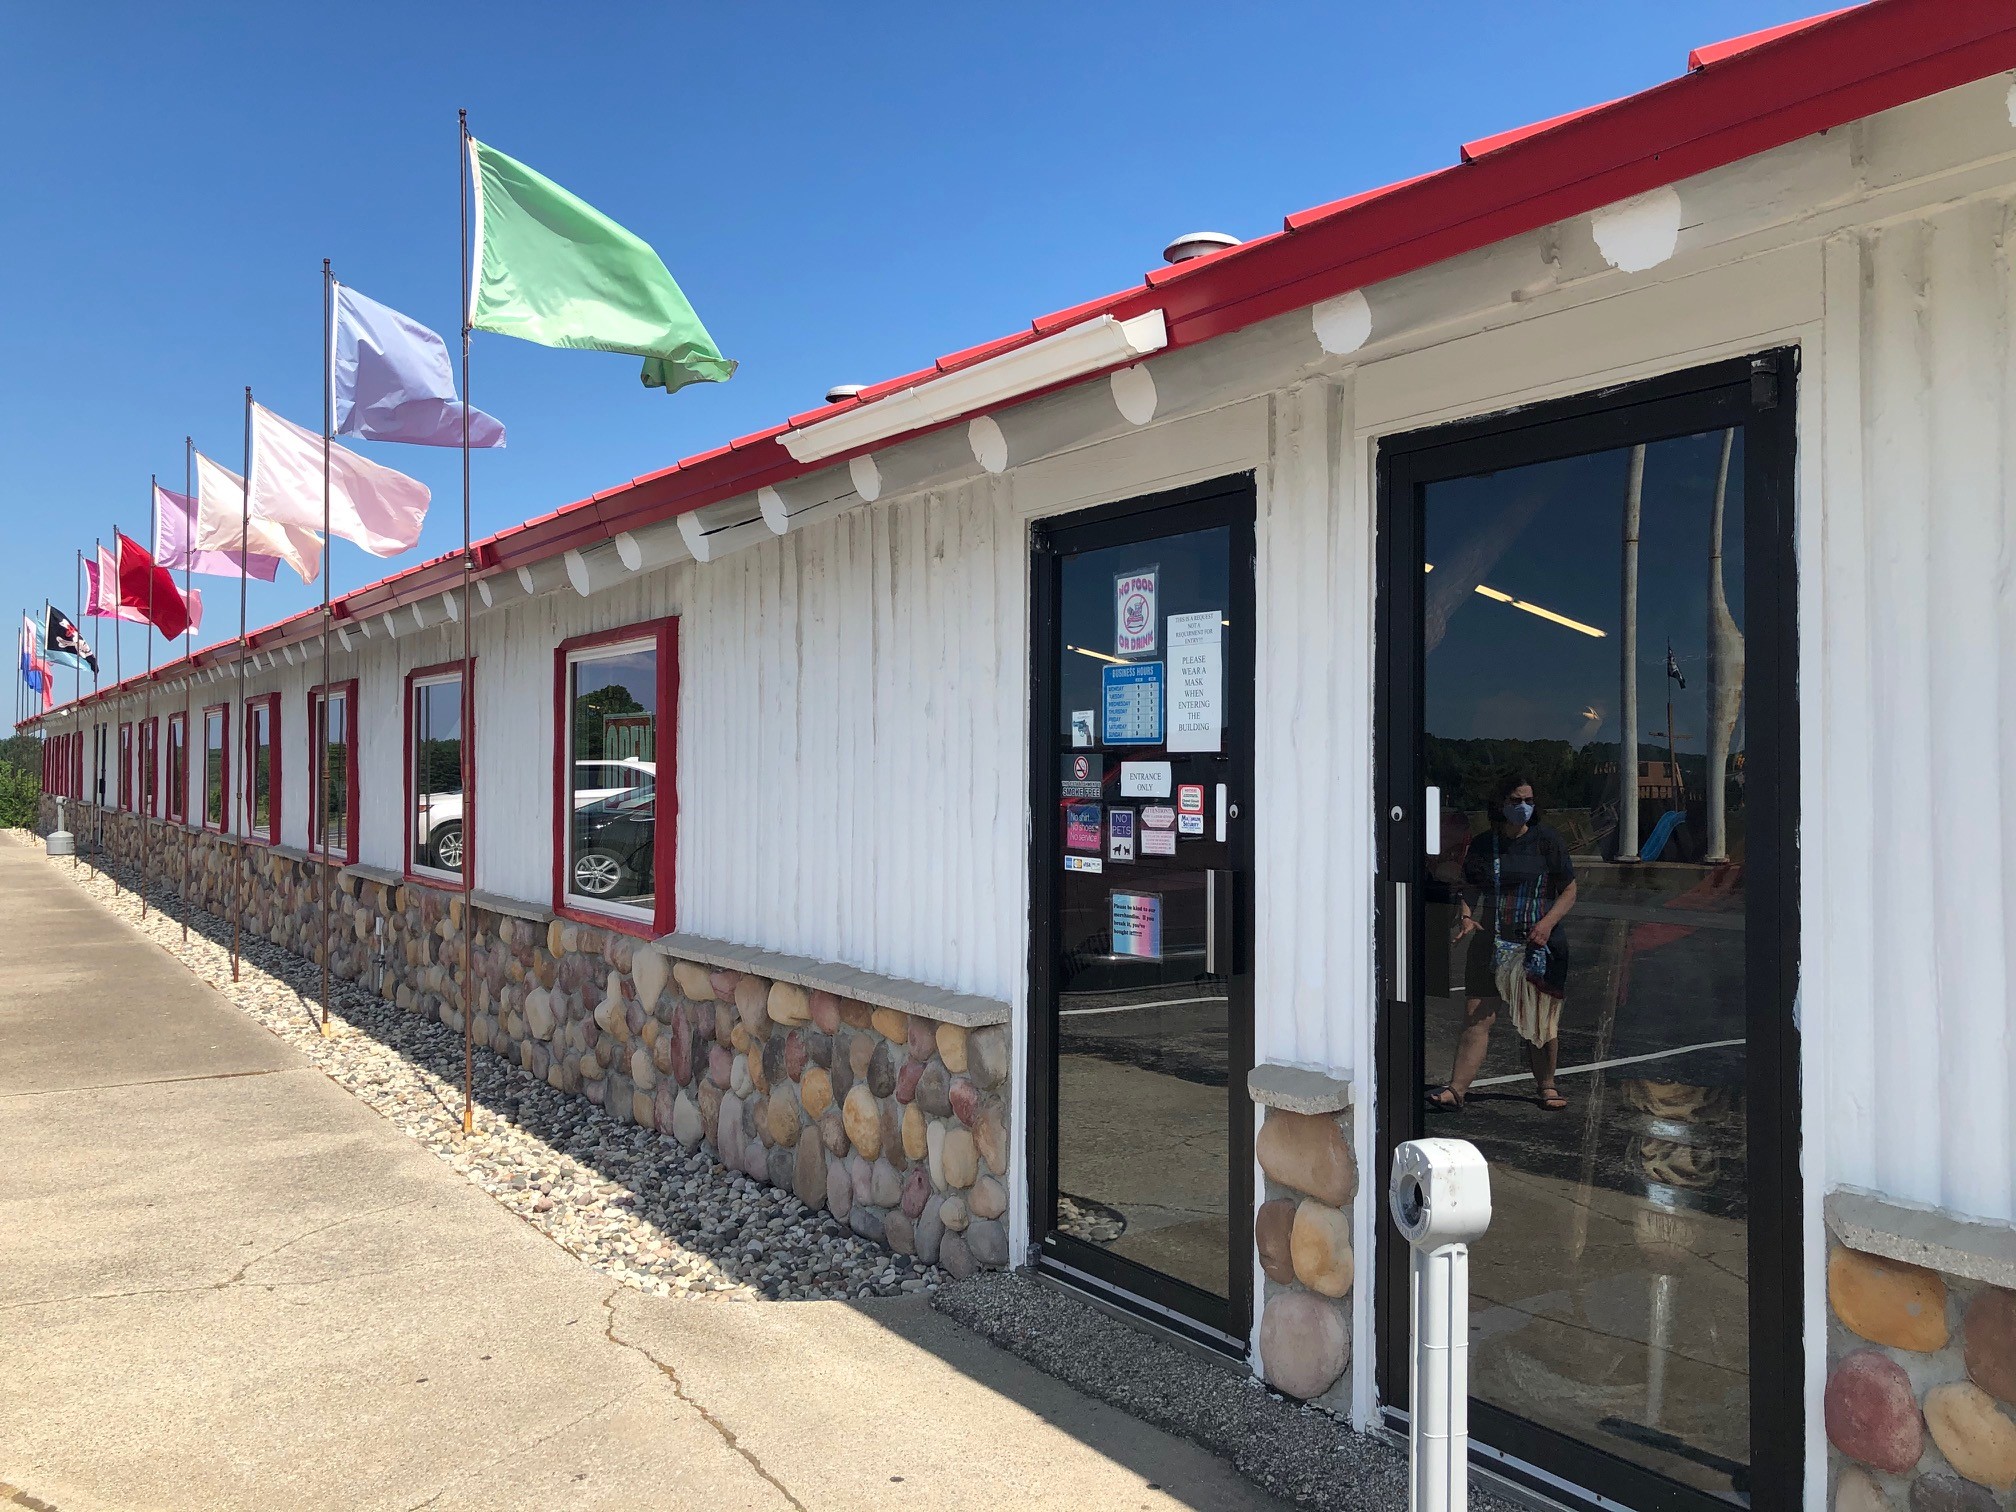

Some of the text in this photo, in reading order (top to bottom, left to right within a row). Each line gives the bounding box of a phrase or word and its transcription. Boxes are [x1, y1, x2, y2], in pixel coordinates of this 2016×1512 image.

[1119, 578, 1153, 599] NO FOOD
[1194, 613, 1213, 621] REQUEST
[1119, 630, 1153, 650] OR DRINK
[1182, 655, 1206, 664] PLEASE
[1112, 666, 1154, 678] BUSINESS HOURS
[1182, 667, 1201, 675] WEAR
[1185, 678, 1204, 687] MASK
[1184, 690, 1204, 698] WHEN
[1178, 700, 1210, 709] ENTERING
[1188, 712, 1201, 720] THE
[1178, 723, 1210, 732] BUILDING
[1130, 772, 1162, 780] ENTRANCE
[1062, 787, 1101, 797] SMOKE FREE
[1070, 811, 1079, 821] No
[1115, 814, 1128, 823] NO
[1070, 822, 1079, 831] No
[1112, 826, 1132, 835] PETS
[1070, 831, 1098, 842] No service
[1114, 928, 1128, 936] bought
